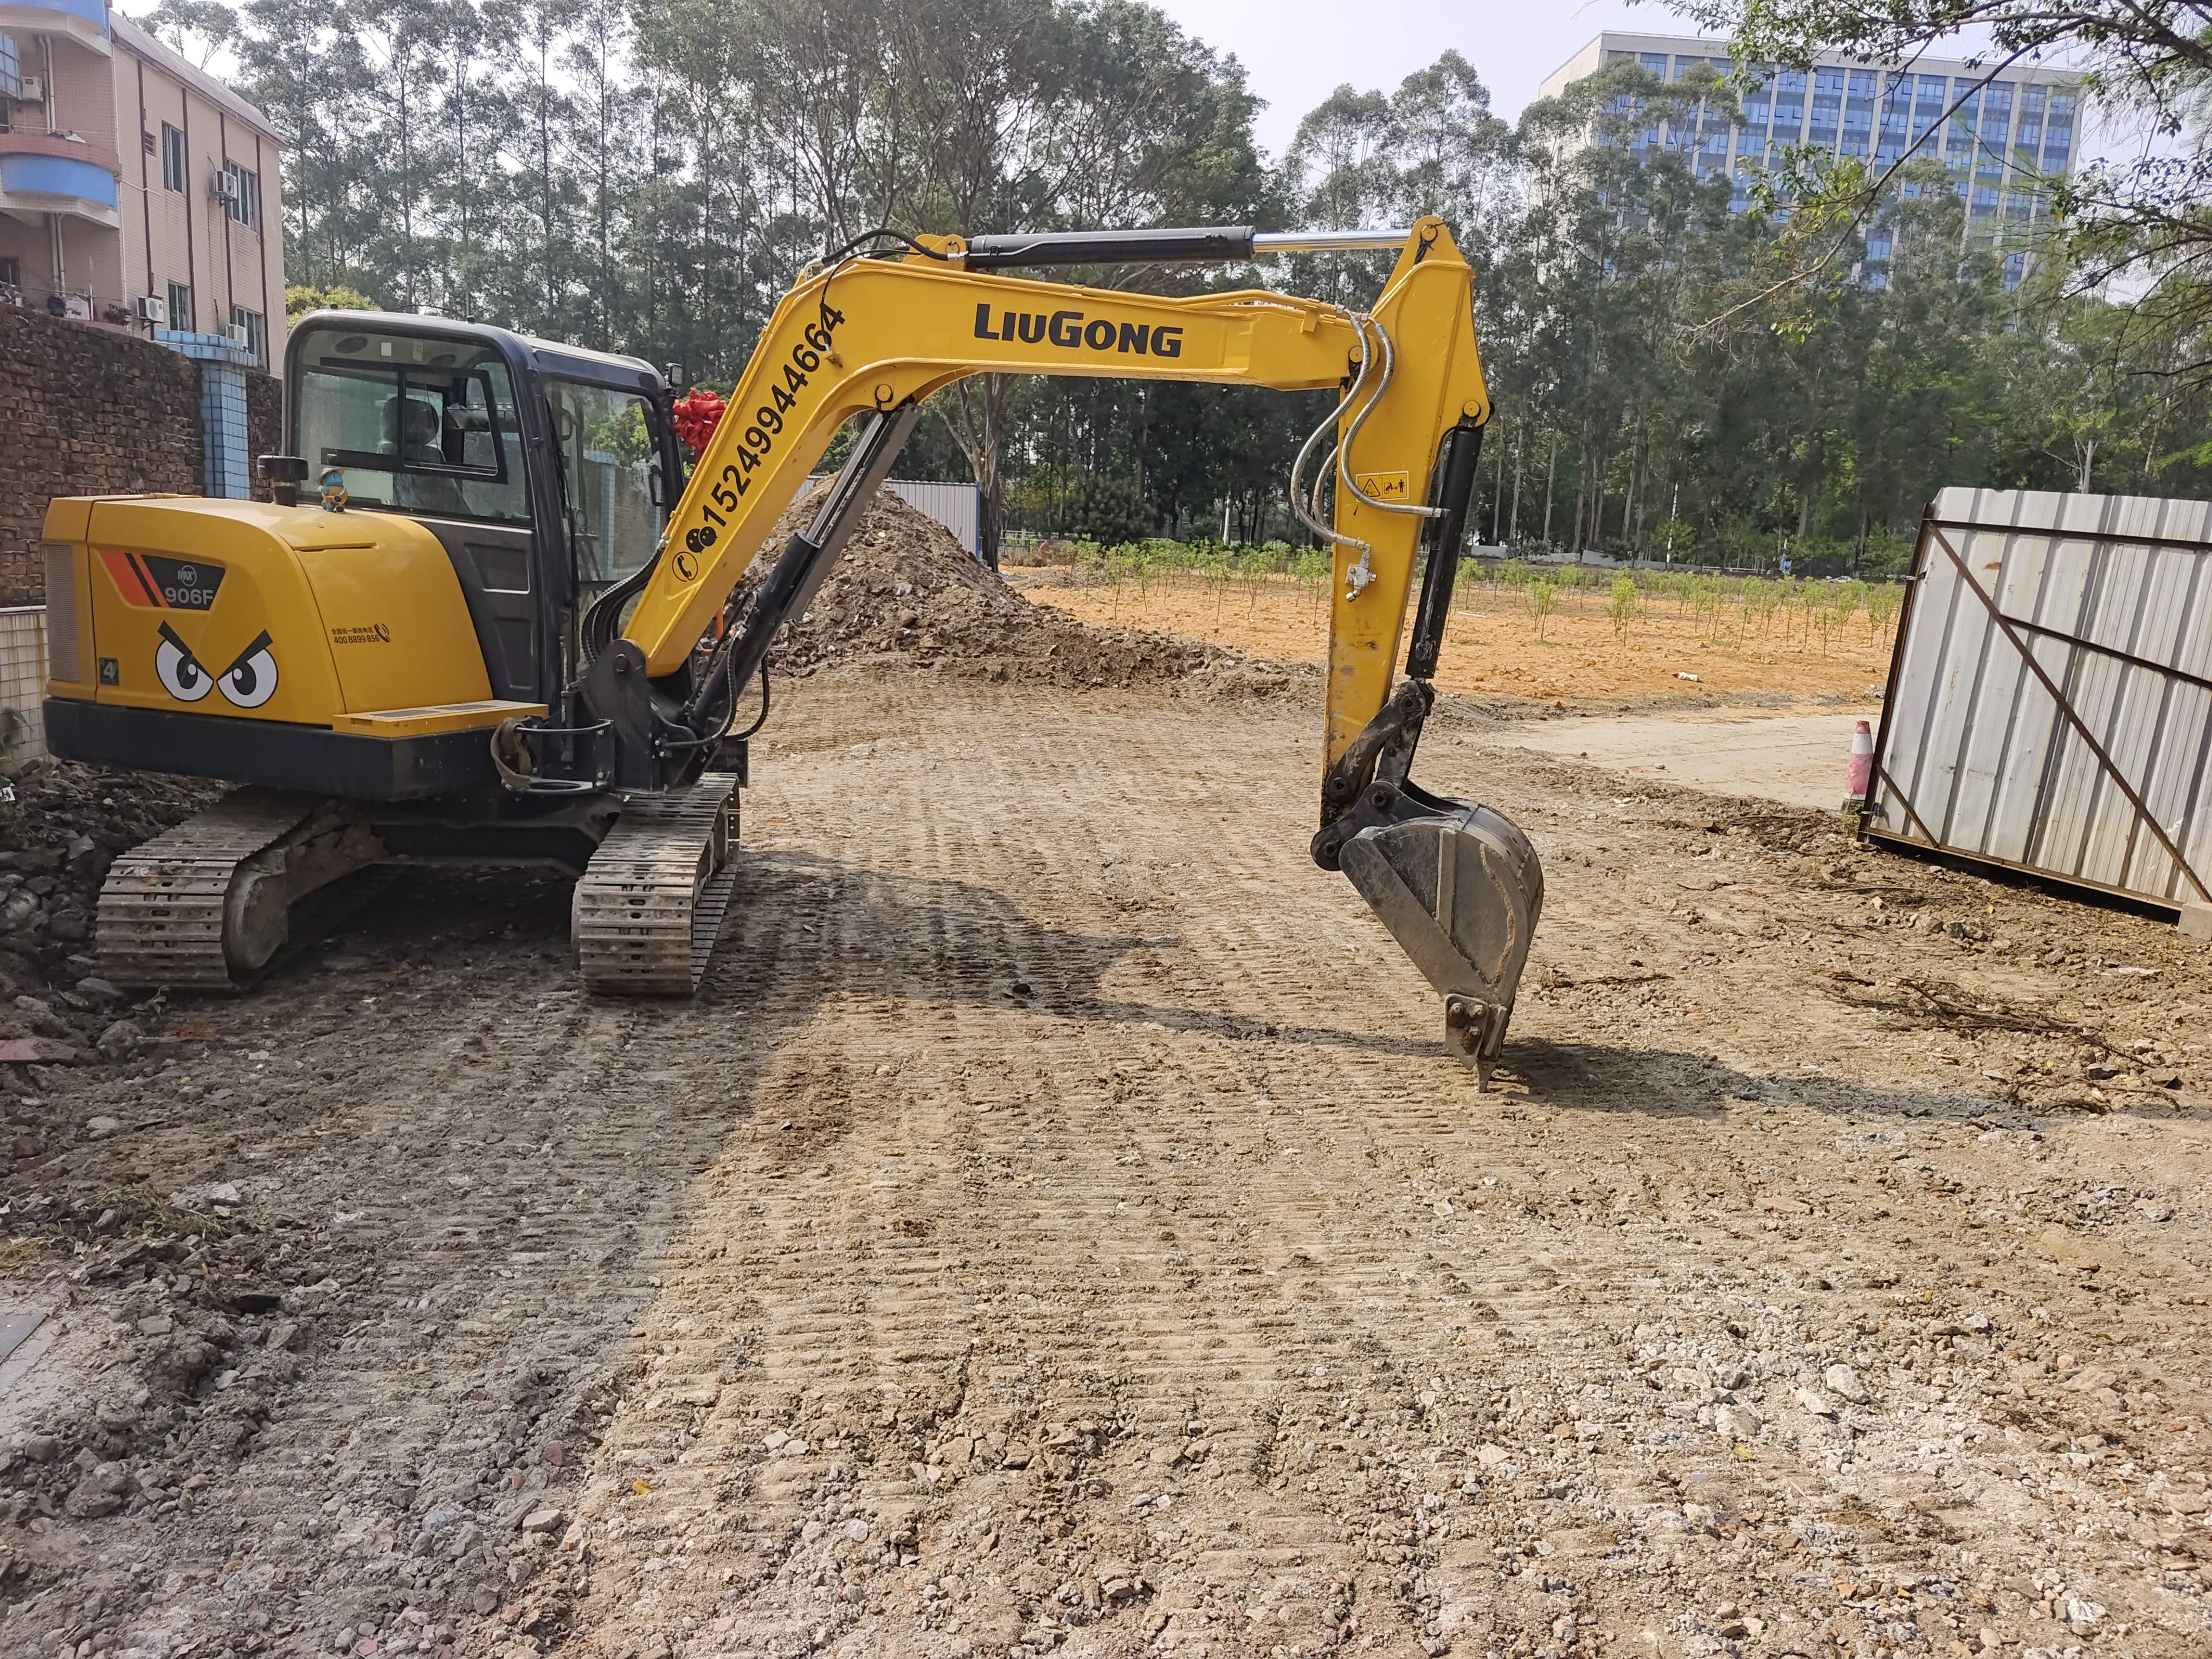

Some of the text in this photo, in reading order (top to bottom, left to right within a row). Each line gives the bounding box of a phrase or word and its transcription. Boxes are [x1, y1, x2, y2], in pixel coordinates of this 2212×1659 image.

[703, 303, 846, 527] 15249944664
[165, 587, 214, 605] 906F
[334, 634, 380, 644] 400 8899 856
[104, 661, 114, 679] 4
